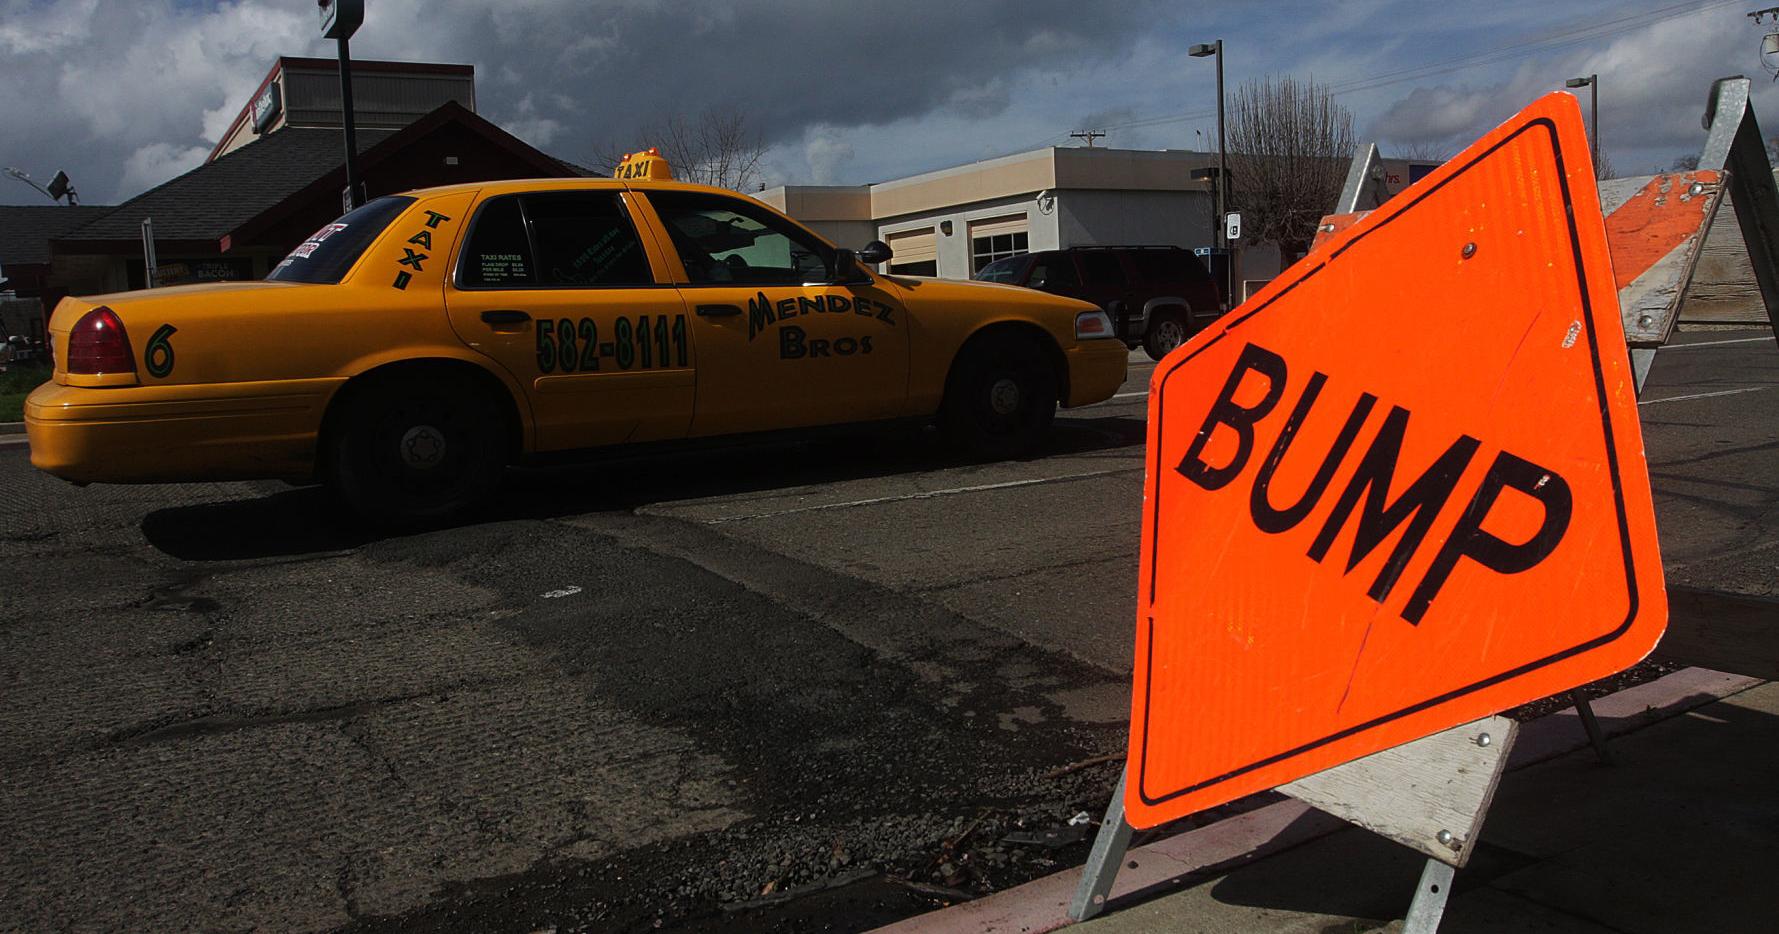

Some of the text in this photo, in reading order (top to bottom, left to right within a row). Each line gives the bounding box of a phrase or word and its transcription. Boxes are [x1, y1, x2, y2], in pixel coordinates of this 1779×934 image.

[616, 160, 650, 179] TAXI
[197, 269, 234, 280] BACON
[392, 210, 451, 290] TAXI
[145, 323, 178, 378] 6
[535, 314, 689, 373] 582-8111
[1174, 341, 1573, 627] BUMP
